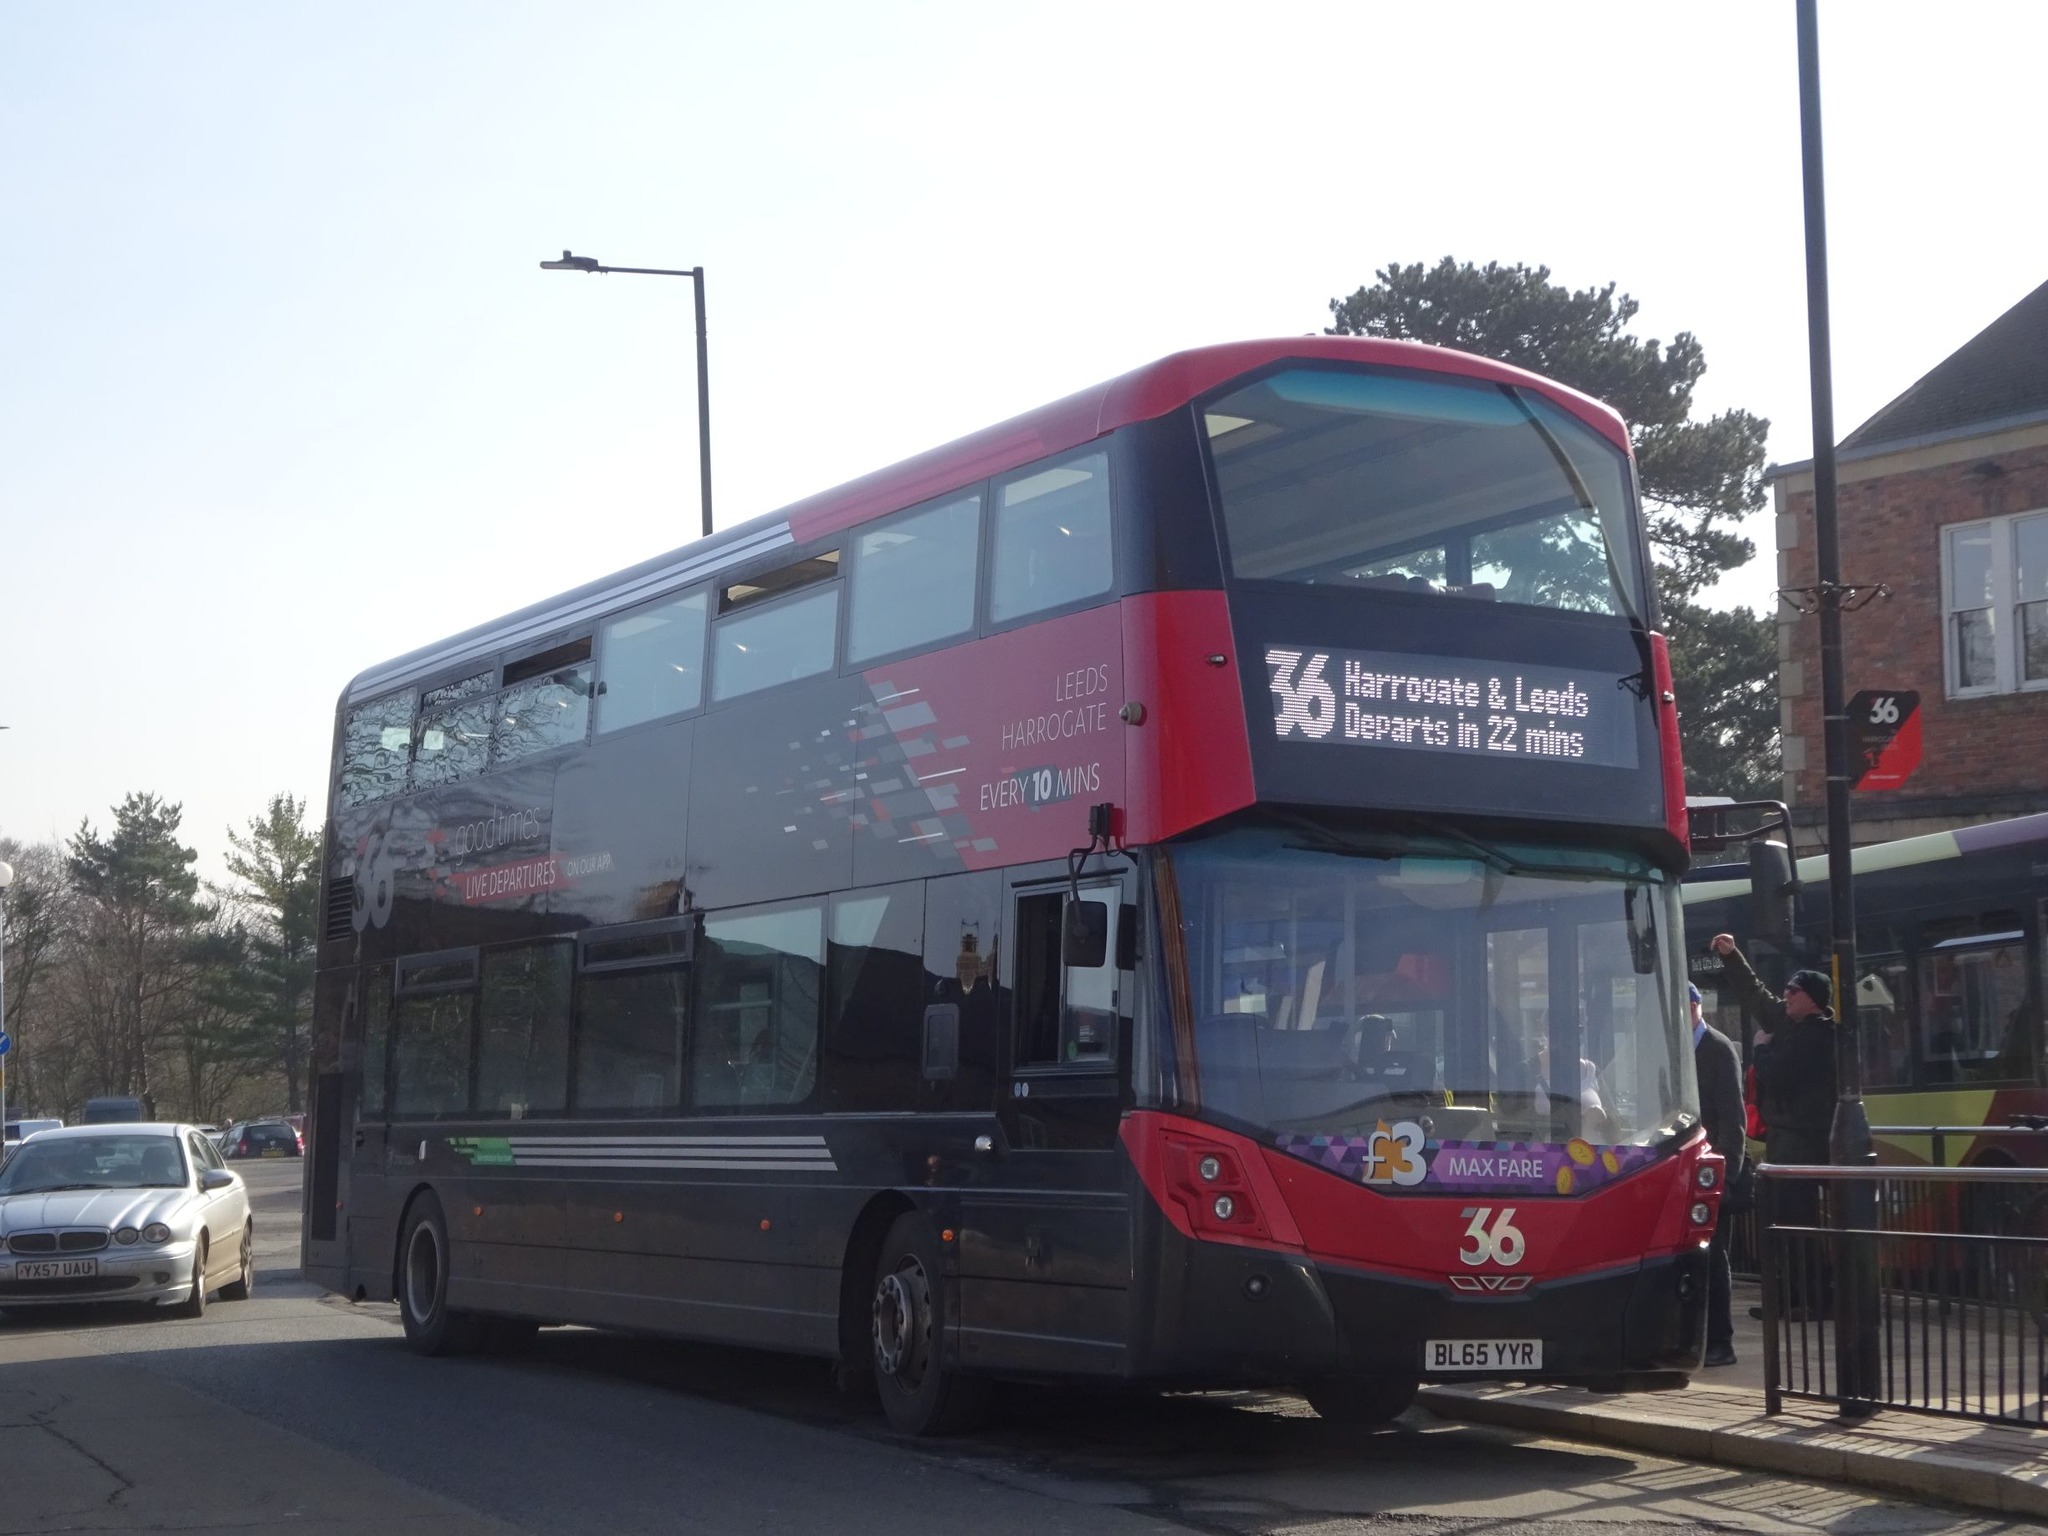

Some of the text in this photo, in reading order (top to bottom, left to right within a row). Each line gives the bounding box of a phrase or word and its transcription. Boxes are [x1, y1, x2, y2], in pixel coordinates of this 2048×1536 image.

[1056, 664, 1108, 702] LEEDS
[1265, 649, 1336, 739] 36
[1345, 660, 1590, 718] Harrogate & Leeds
[1002, 702, 1107, 750] HARROGATE
[1344, 702, 1585, 757] Departs in 22 mins
[1869, 697, 1900, 724] 36
[980, 762, 1101, 811] EVERY 10 MINS
[455, 803, 541, 867] good times
[466, 873, 487, 899] LIVE
[490, 860, 556, 896] DEPARTURES
[1362, 1121, 1543, 1186] £3 MAX FARE
[1460, 1207, 1526, 1266] 36
[24, 1261, 90, 1277] YX57 UAU
[1434, 1342, 1533, 1366] BL65 YYR
